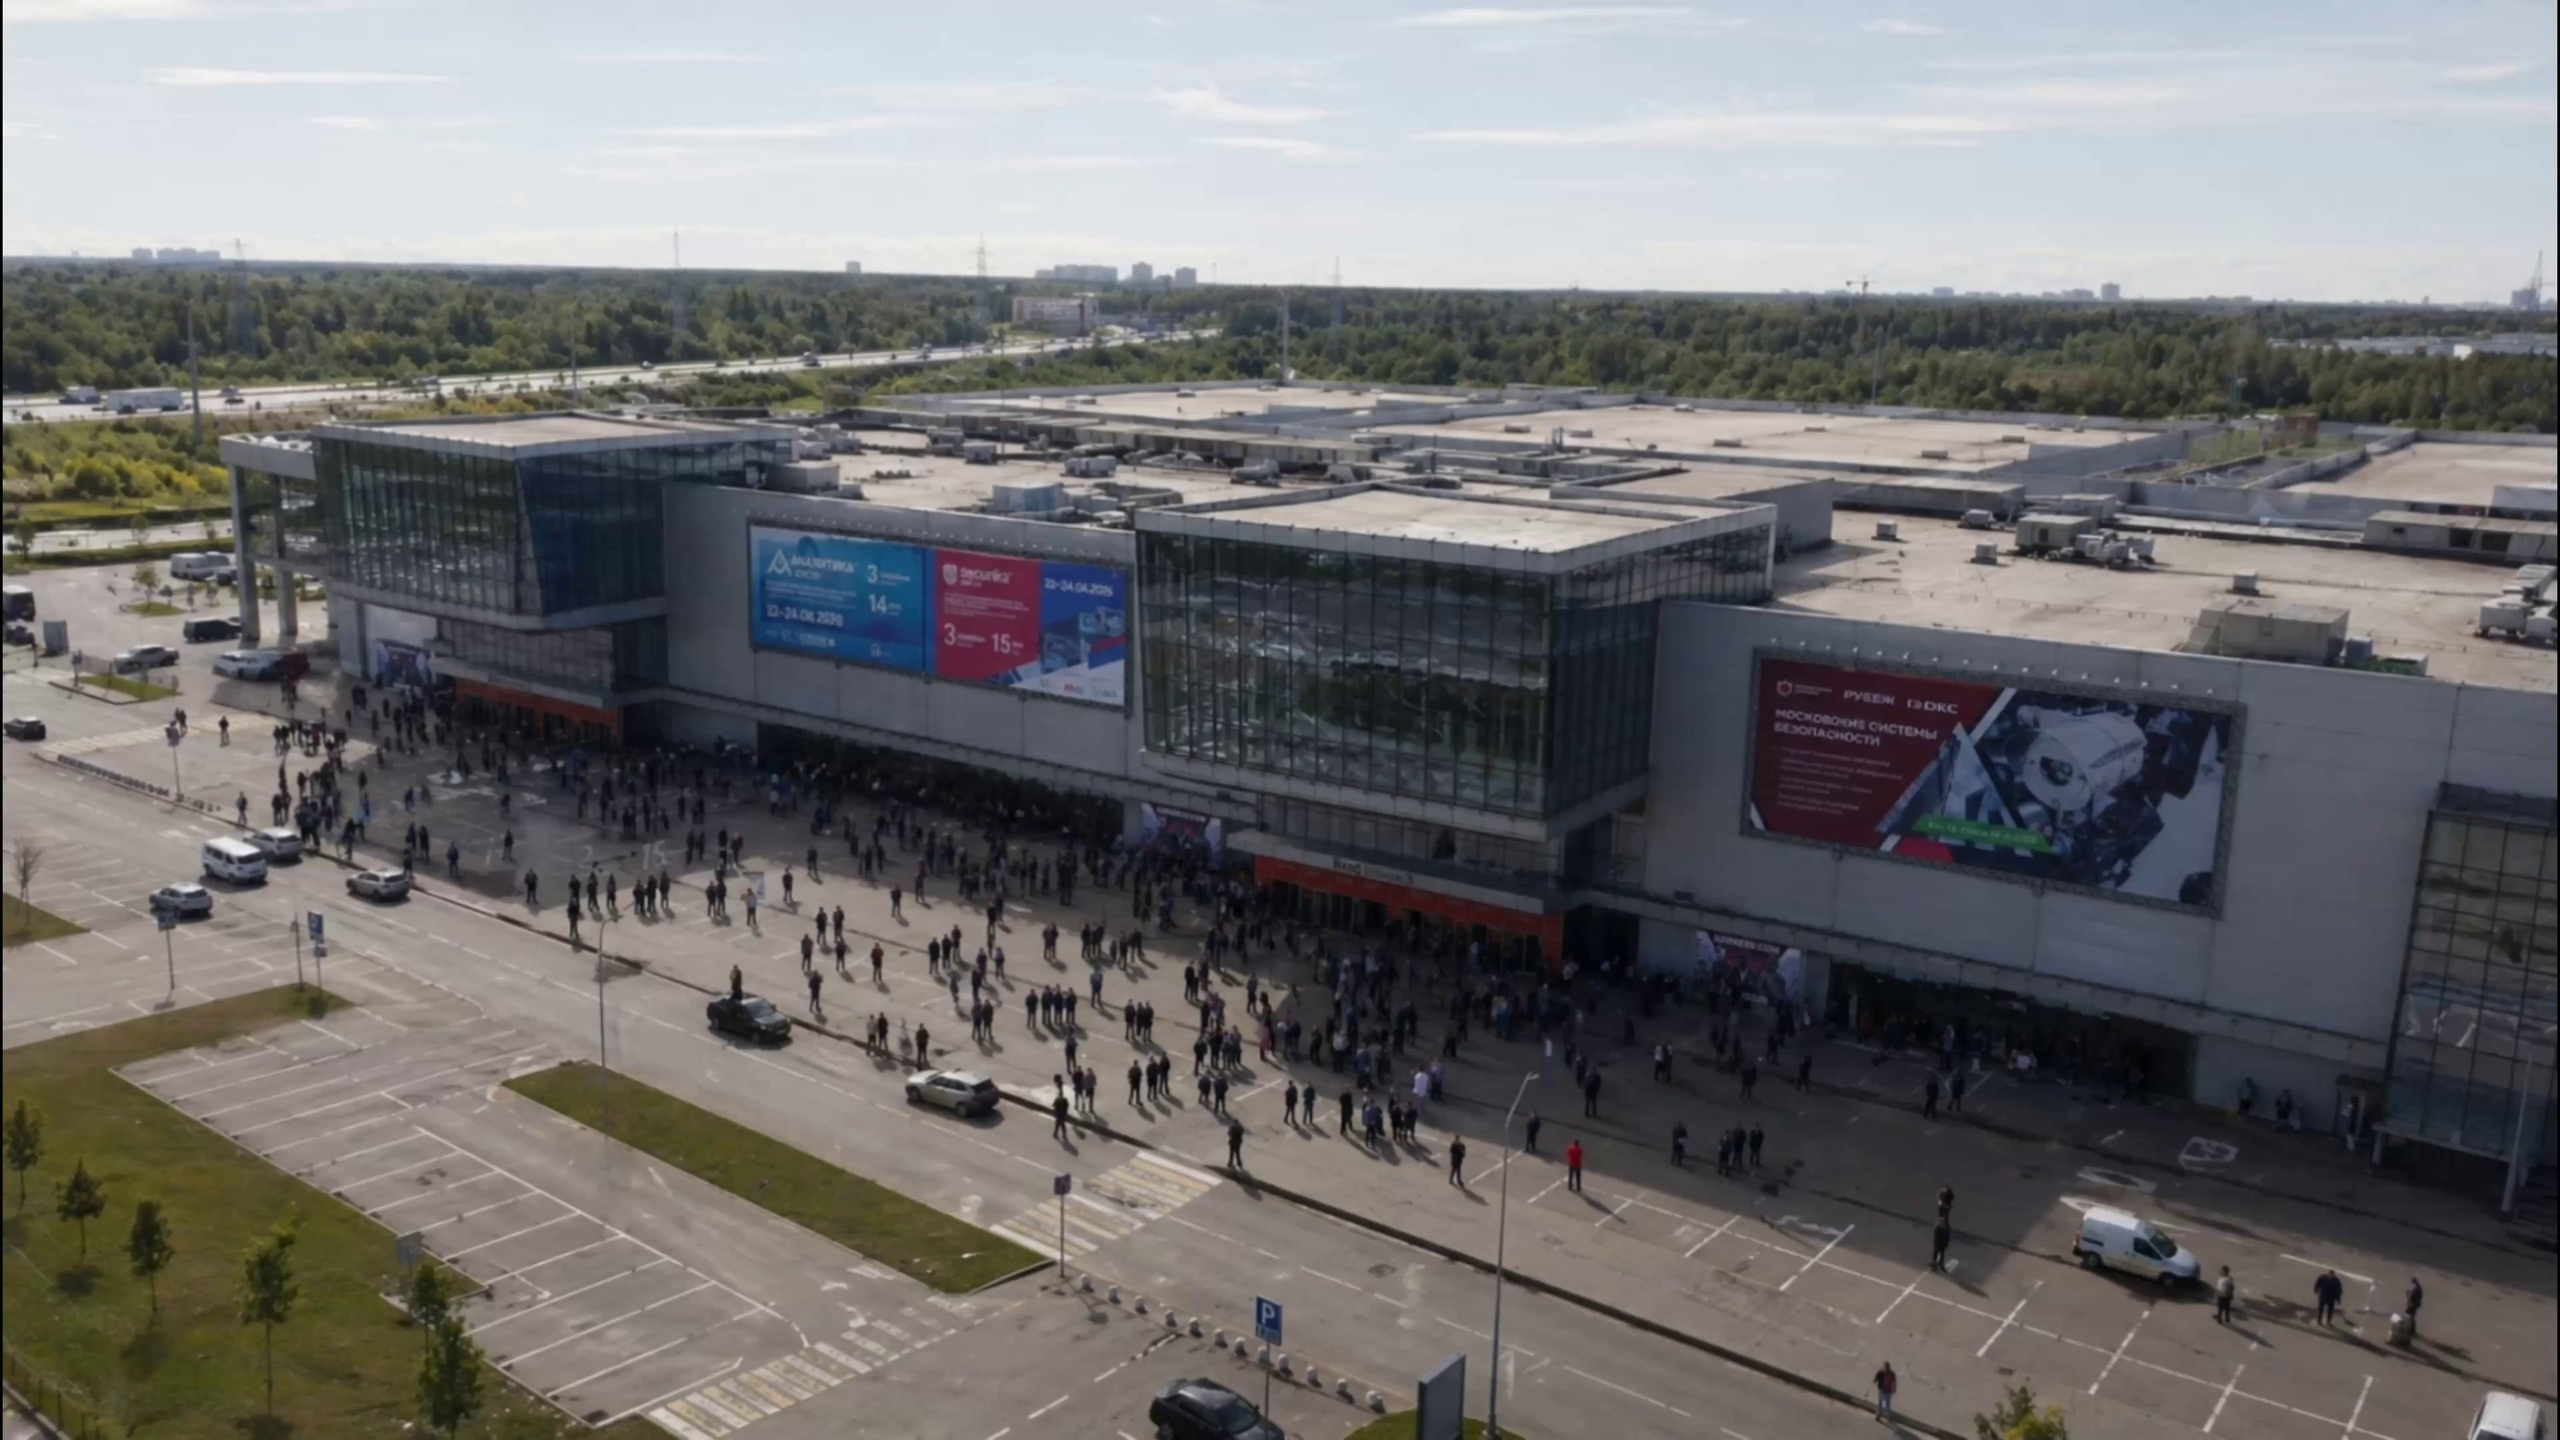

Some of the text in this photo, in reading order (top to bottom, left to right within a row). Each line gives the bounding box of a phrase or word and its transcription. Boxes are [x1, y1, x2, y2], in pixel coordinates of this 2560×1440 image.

[867, 564, 878, 585] 3
[868, 593, 888, 614] 14
[944, 623, 956, 645] 3
[992, 633, 1011, 654] 15
[1843, 690, 1895, 706] РУБЕЖ
[1774, 722, 1881, 747] БЕЗОПАСНОСТИ
[1869, 720, 1938, 741] СИСТЕМЫ
[1261, 1303, 1276, 1325] P
